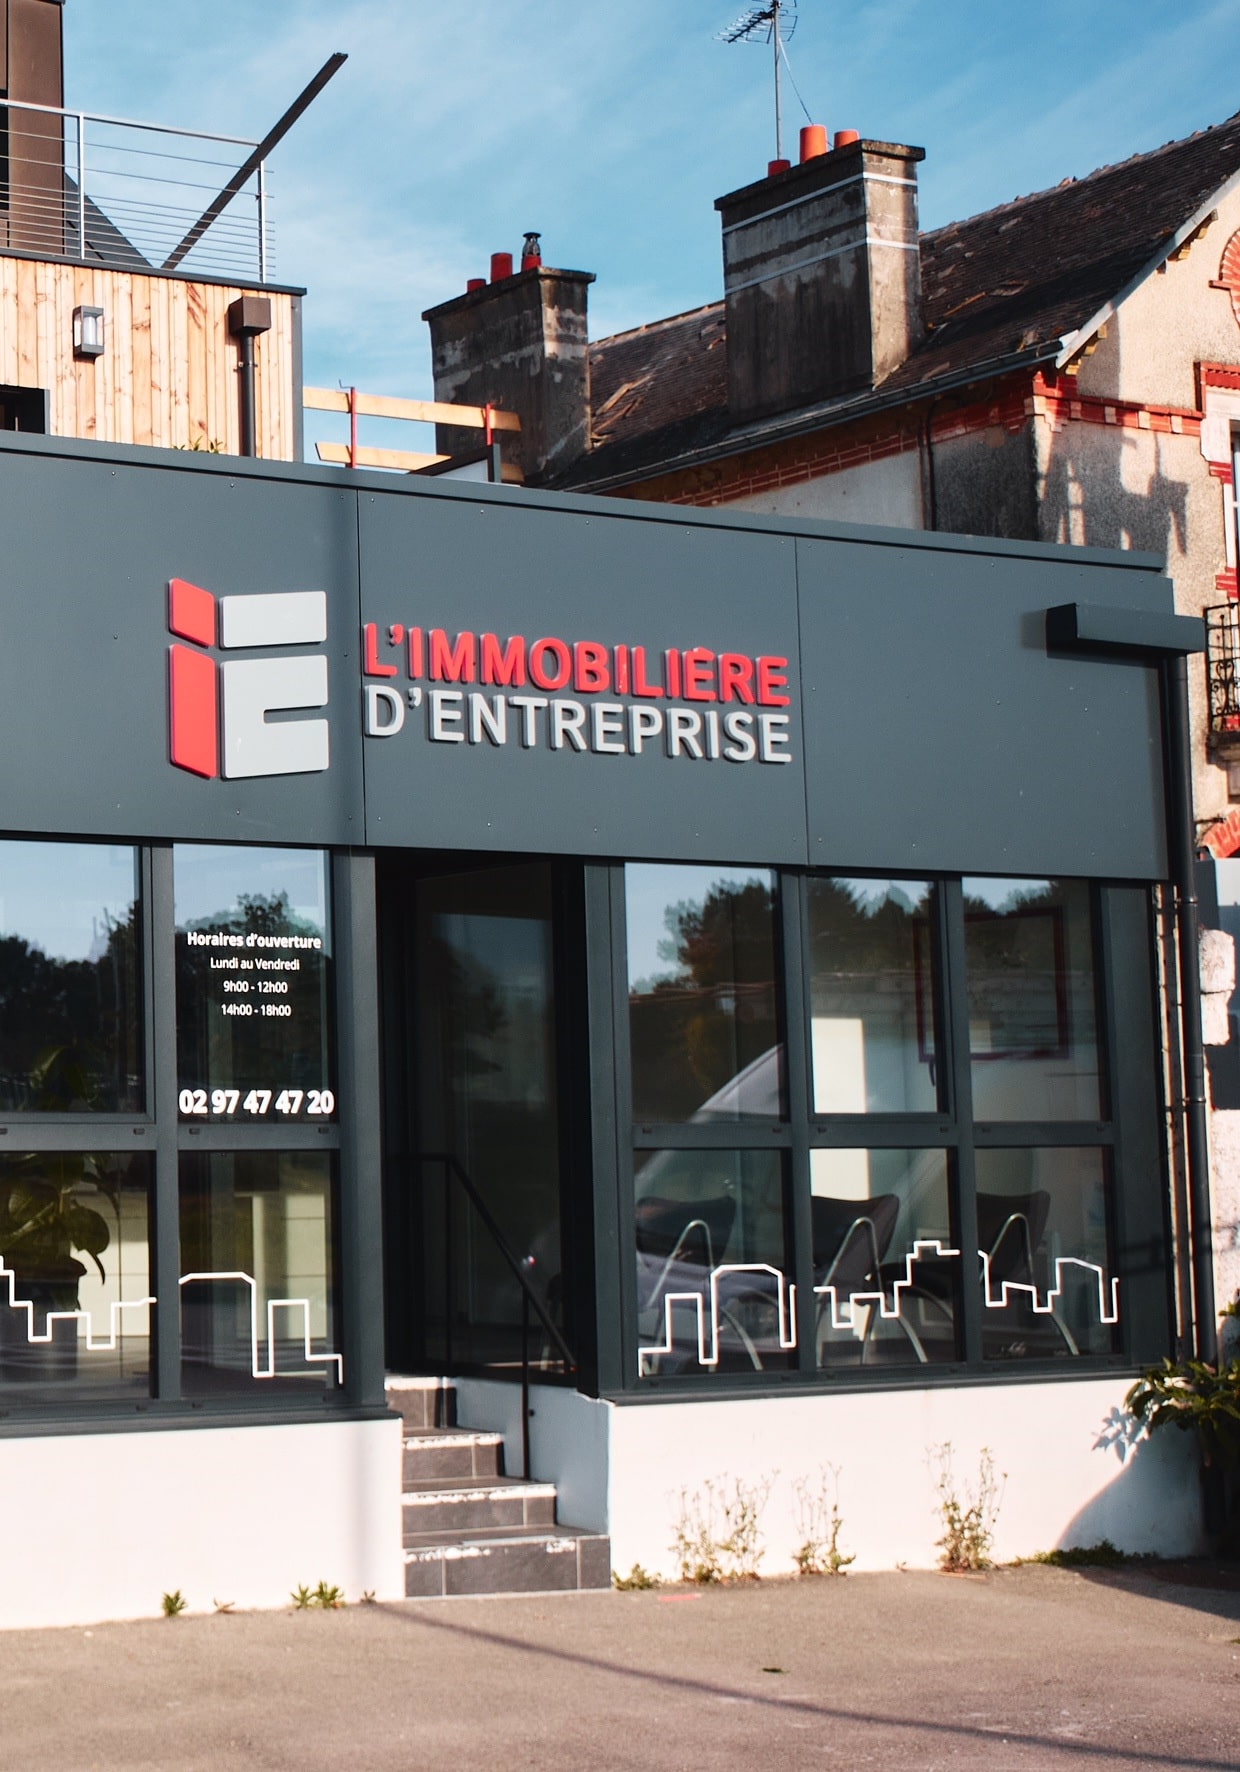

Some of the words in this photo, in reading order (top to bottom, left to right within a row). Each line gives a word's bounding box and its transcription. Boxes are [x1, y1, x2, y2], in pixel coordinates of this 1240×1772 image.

[364, 622, 790, 707] L'IMMOBILIÈRE
[364, 684, 792, 763] D'ENTREPRISE
[187, 931, 244, 947] Horaires
[246, 932, 322, 949] d'ouverture
[210, 956, 239, 969] Lundi
[240, 959, 254, 970] au
[255, 957, 301, 971] Vendredi
[223, 980, 249, 993] 9h00
[257, 981, 288, 994] 12h00
[221, 1003, 253, 1016] 14h00
[261, 1004, 292, 1017] 18h00
[178, 1088, 208, 1114] 02
[211, 1089, 240, 1114] 97
[243, 1089, 272, 1114] 47
[275, 1089, 304, 1114] 47
[307, 1089, 335, 1114] 20
